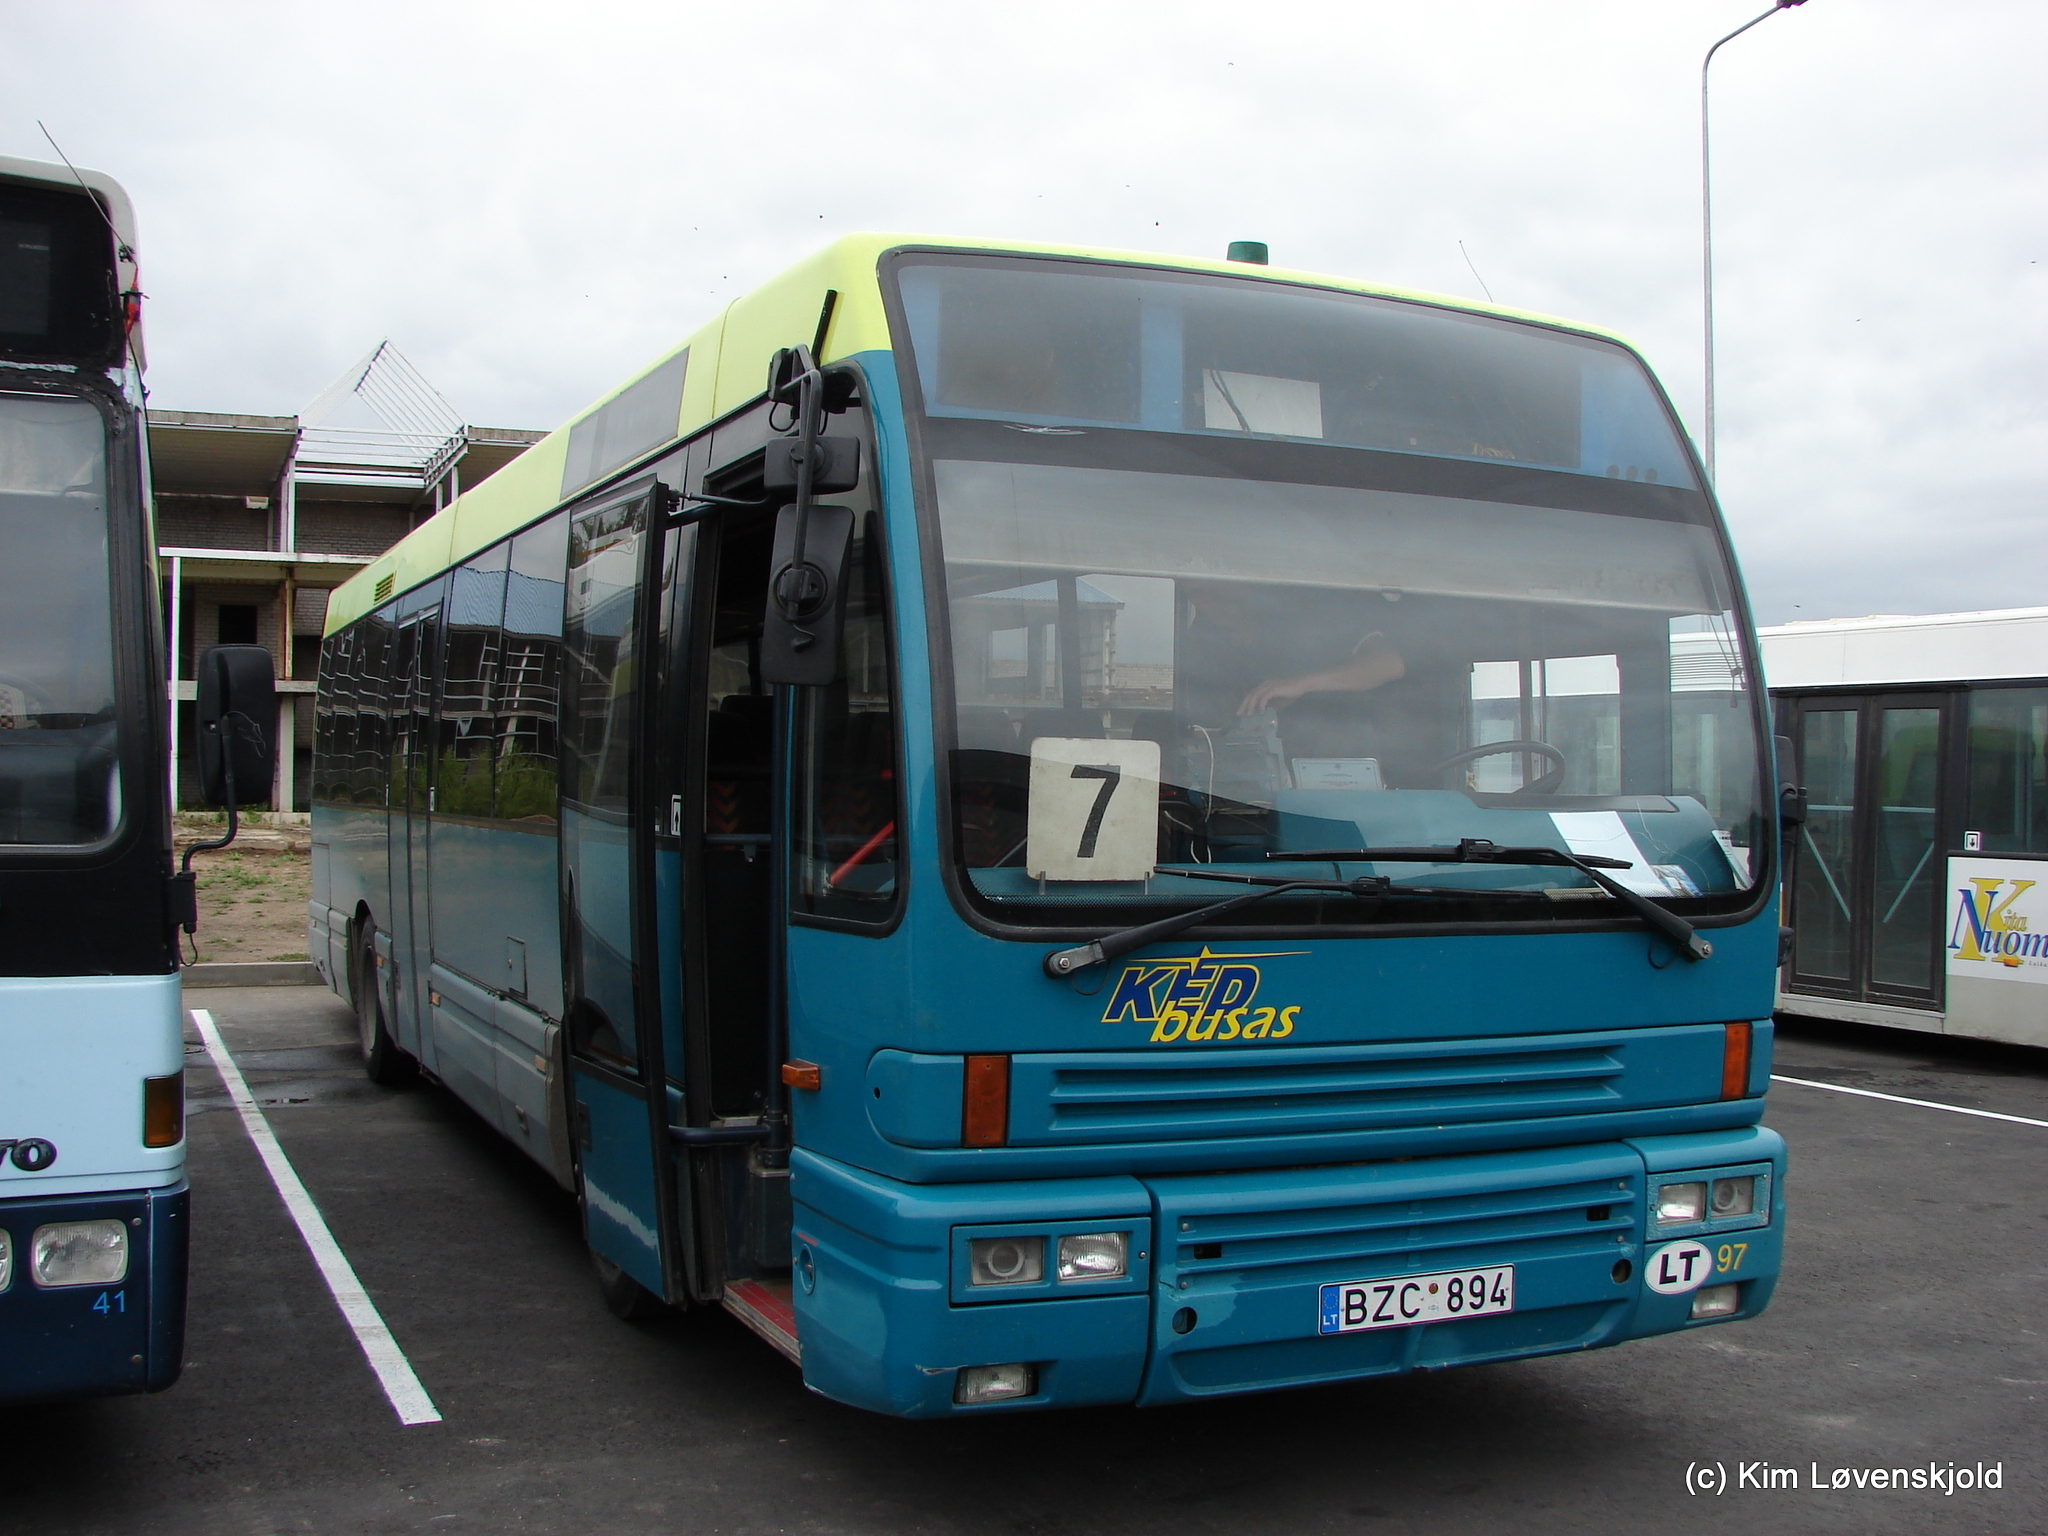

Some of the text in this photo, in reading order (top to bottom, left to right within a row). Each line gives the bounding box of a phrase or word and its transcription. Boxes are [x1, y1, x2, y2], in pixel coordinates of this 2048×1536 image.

[1070, 764, 1121, 858] 7
[1101, 964, 1261, 1023] KED
[1149, 1001, 1302, 1042] busas
[1658, 1249, 1701, 1285] LT
[1716, 1243, 1748, 1273] 97
[92, 1290, 125, 1314] 41
[1345, 1272, 1507, 1326] BZC 894
[1322, 1314, 1339, 1326] LT
